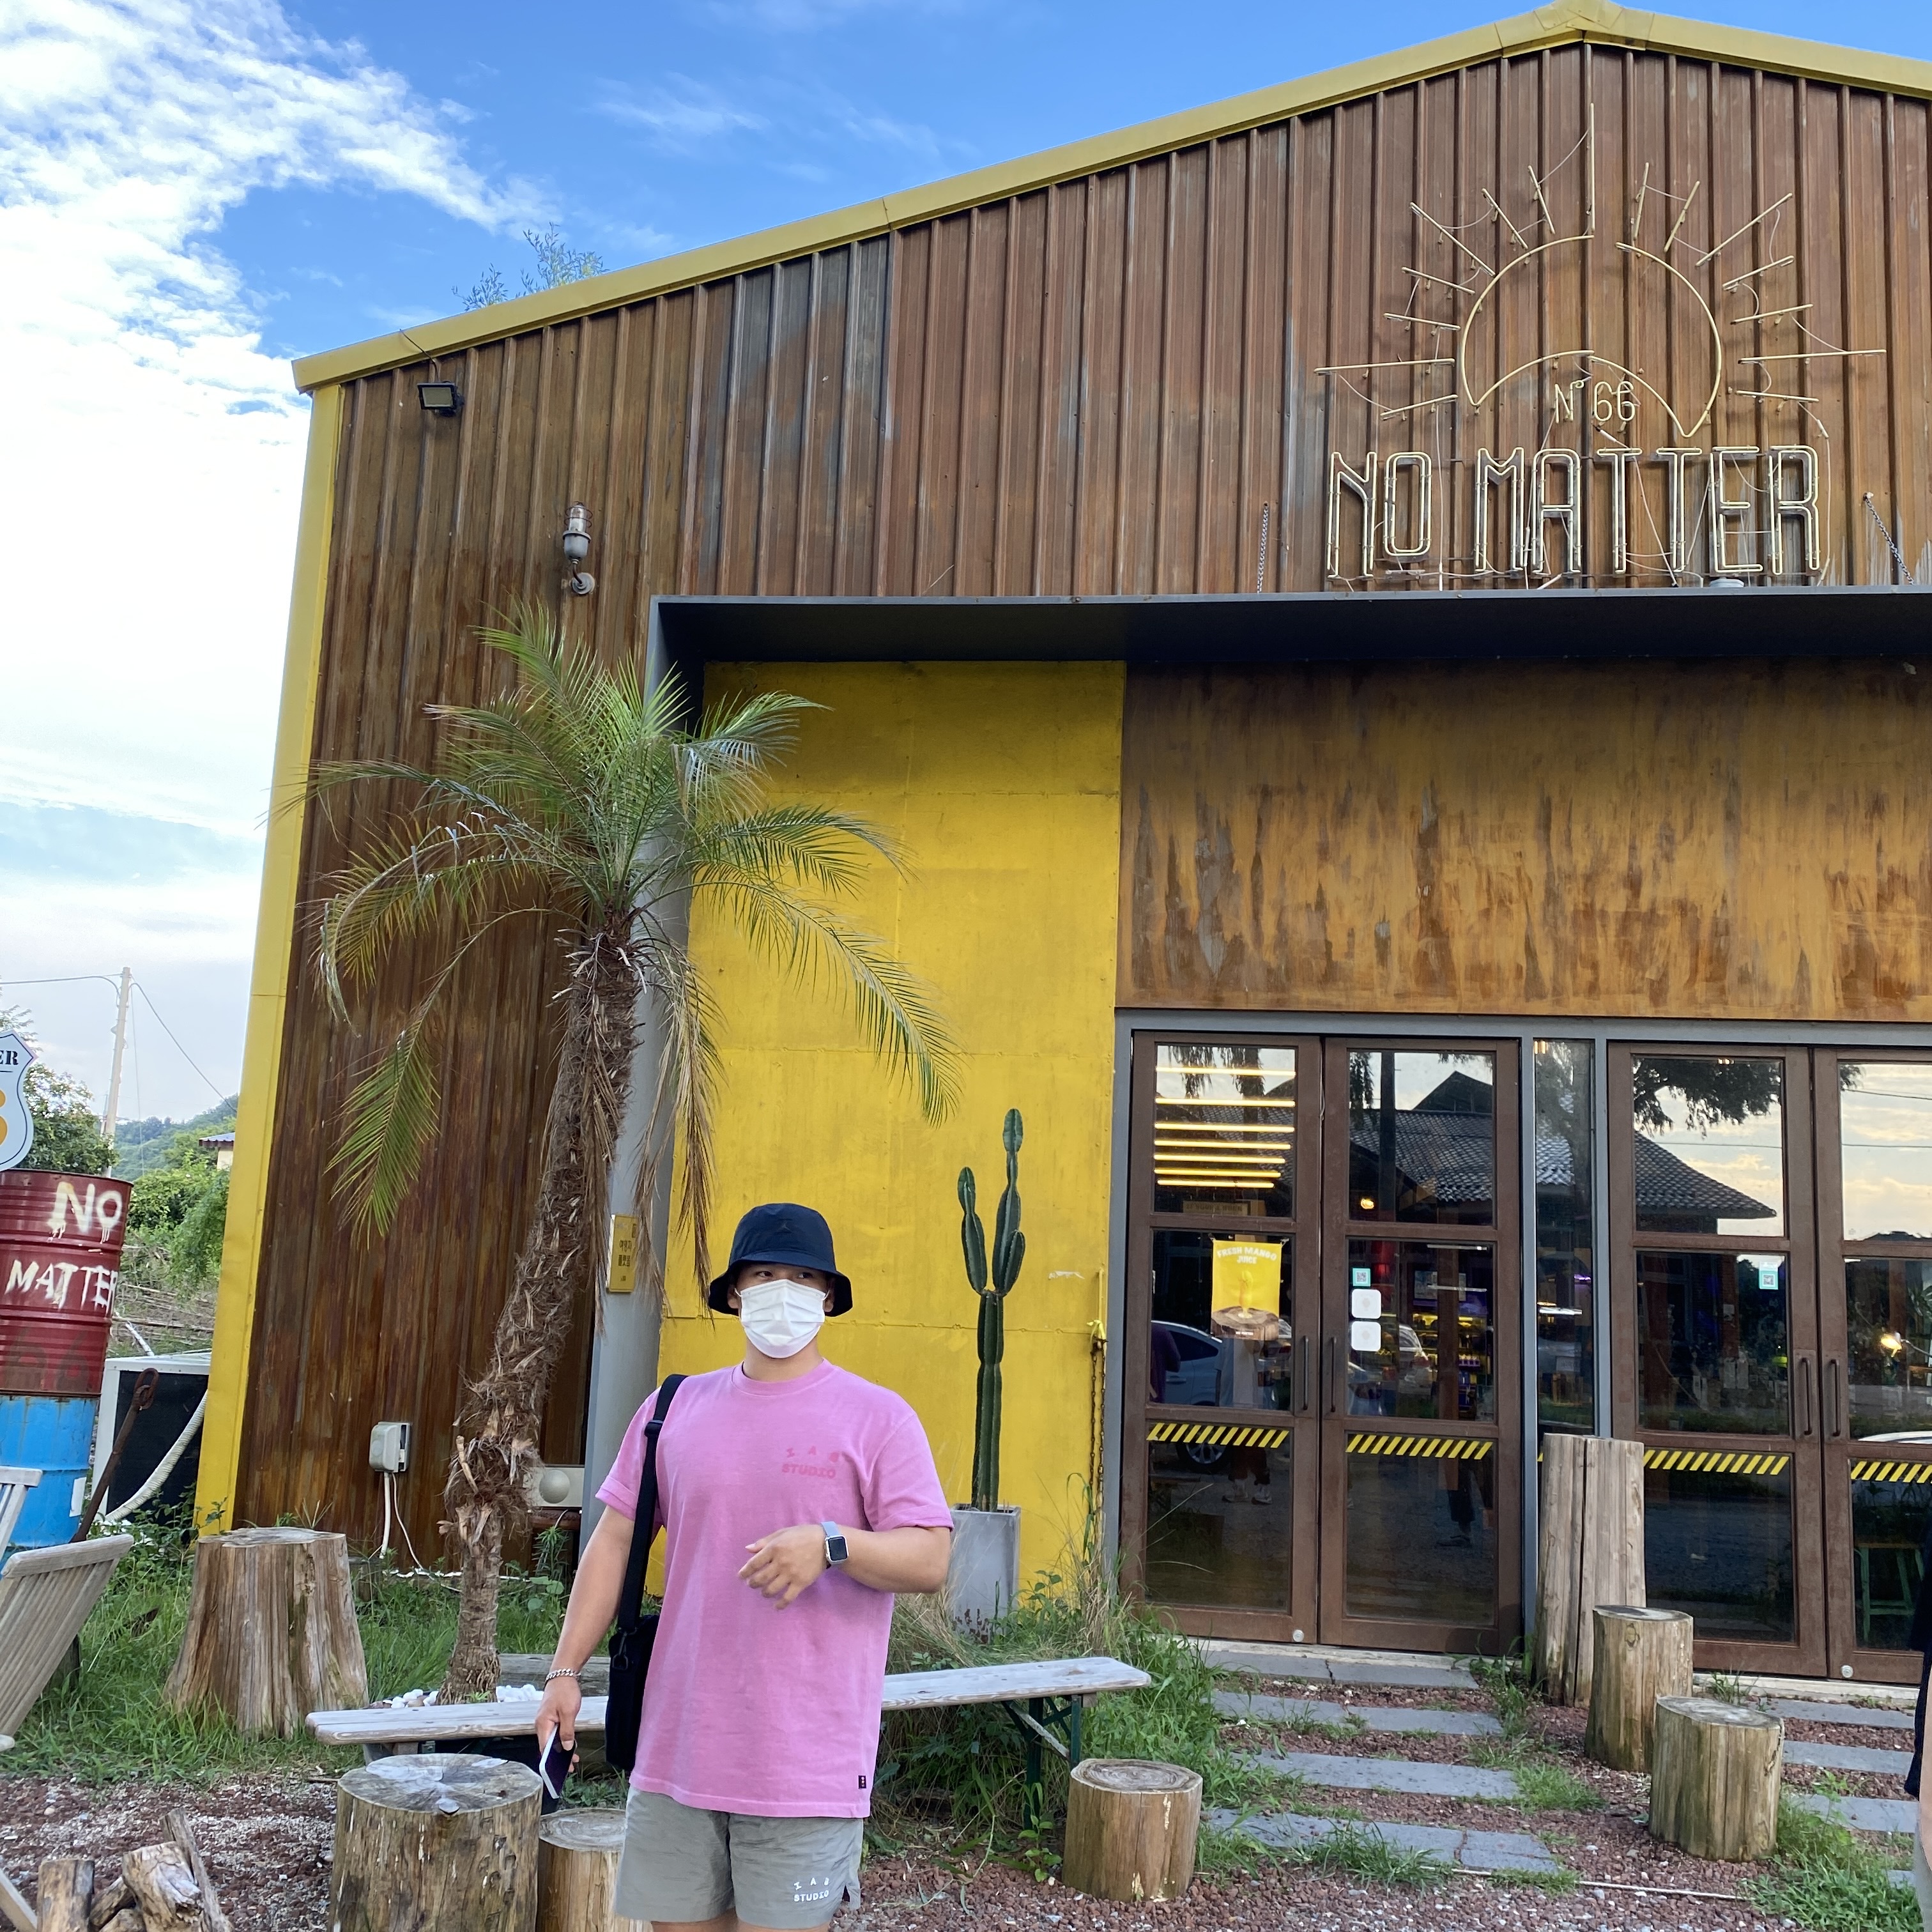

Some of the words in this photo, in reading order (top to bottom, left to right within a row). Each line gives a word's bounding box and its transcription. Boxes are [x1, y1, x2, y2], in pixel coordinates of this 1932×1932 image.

[1594, 381, 1636, 422] 66
[1327, 451, 1432, 579] NO
[1475, 445, 1821, 576] MATTER
[1216, 1246, 1243, 1258] FRESH
[1244, 1246, 1277, 1261] MANGO
[1237, 1256, 1257, 1264] JUICE
[781, 1463, 836, 1478] STUDIO
[793, 1890, 829, 1902] STUDIO
